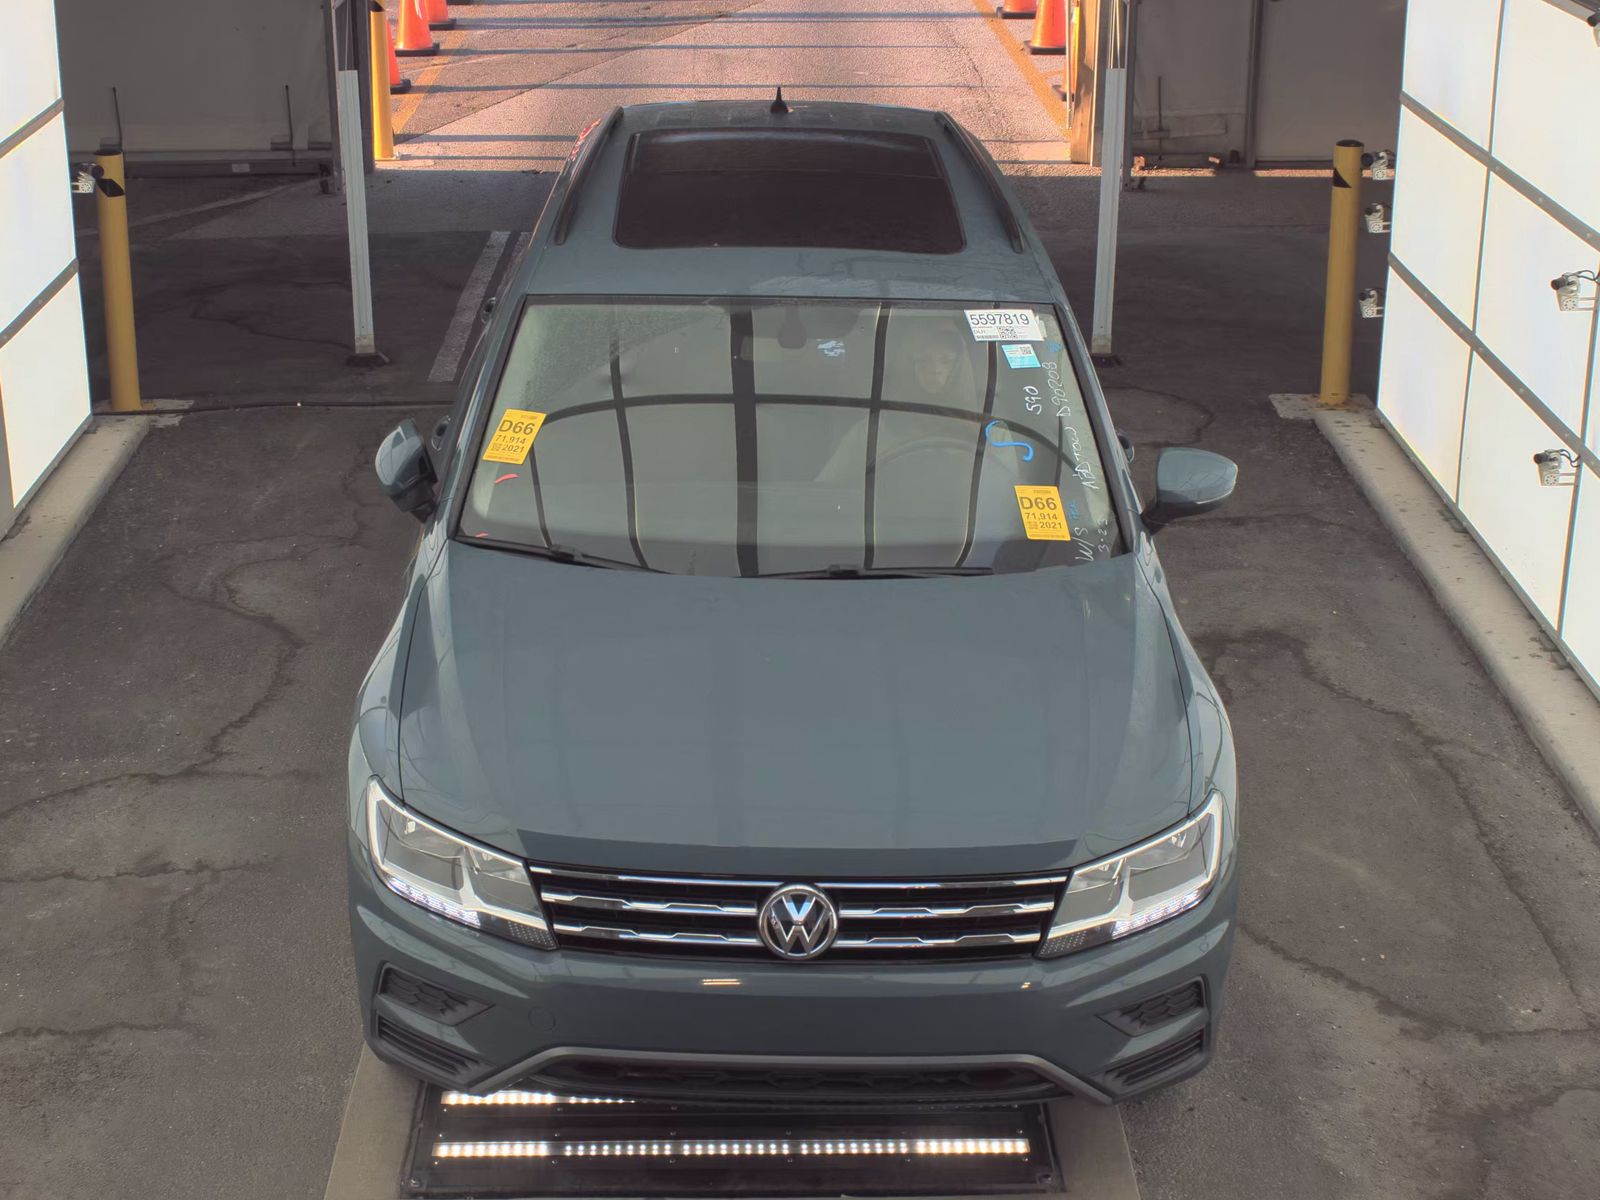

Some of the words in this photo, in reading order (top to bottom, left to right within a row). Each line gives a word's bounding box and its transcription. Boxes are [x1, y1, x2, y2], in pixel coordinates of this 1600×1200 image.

[969, 313, 1030, 326] 5597819
[499, 419, 535, 436] D66
[495, 434, 527, 445] 71,914
[502, 443, 525, 453] 2021
[1019, 496, 1057, 510] D66
[1025, 512, 1058, 521] 71,914
[1039, 521, 1063, 529] 2021
